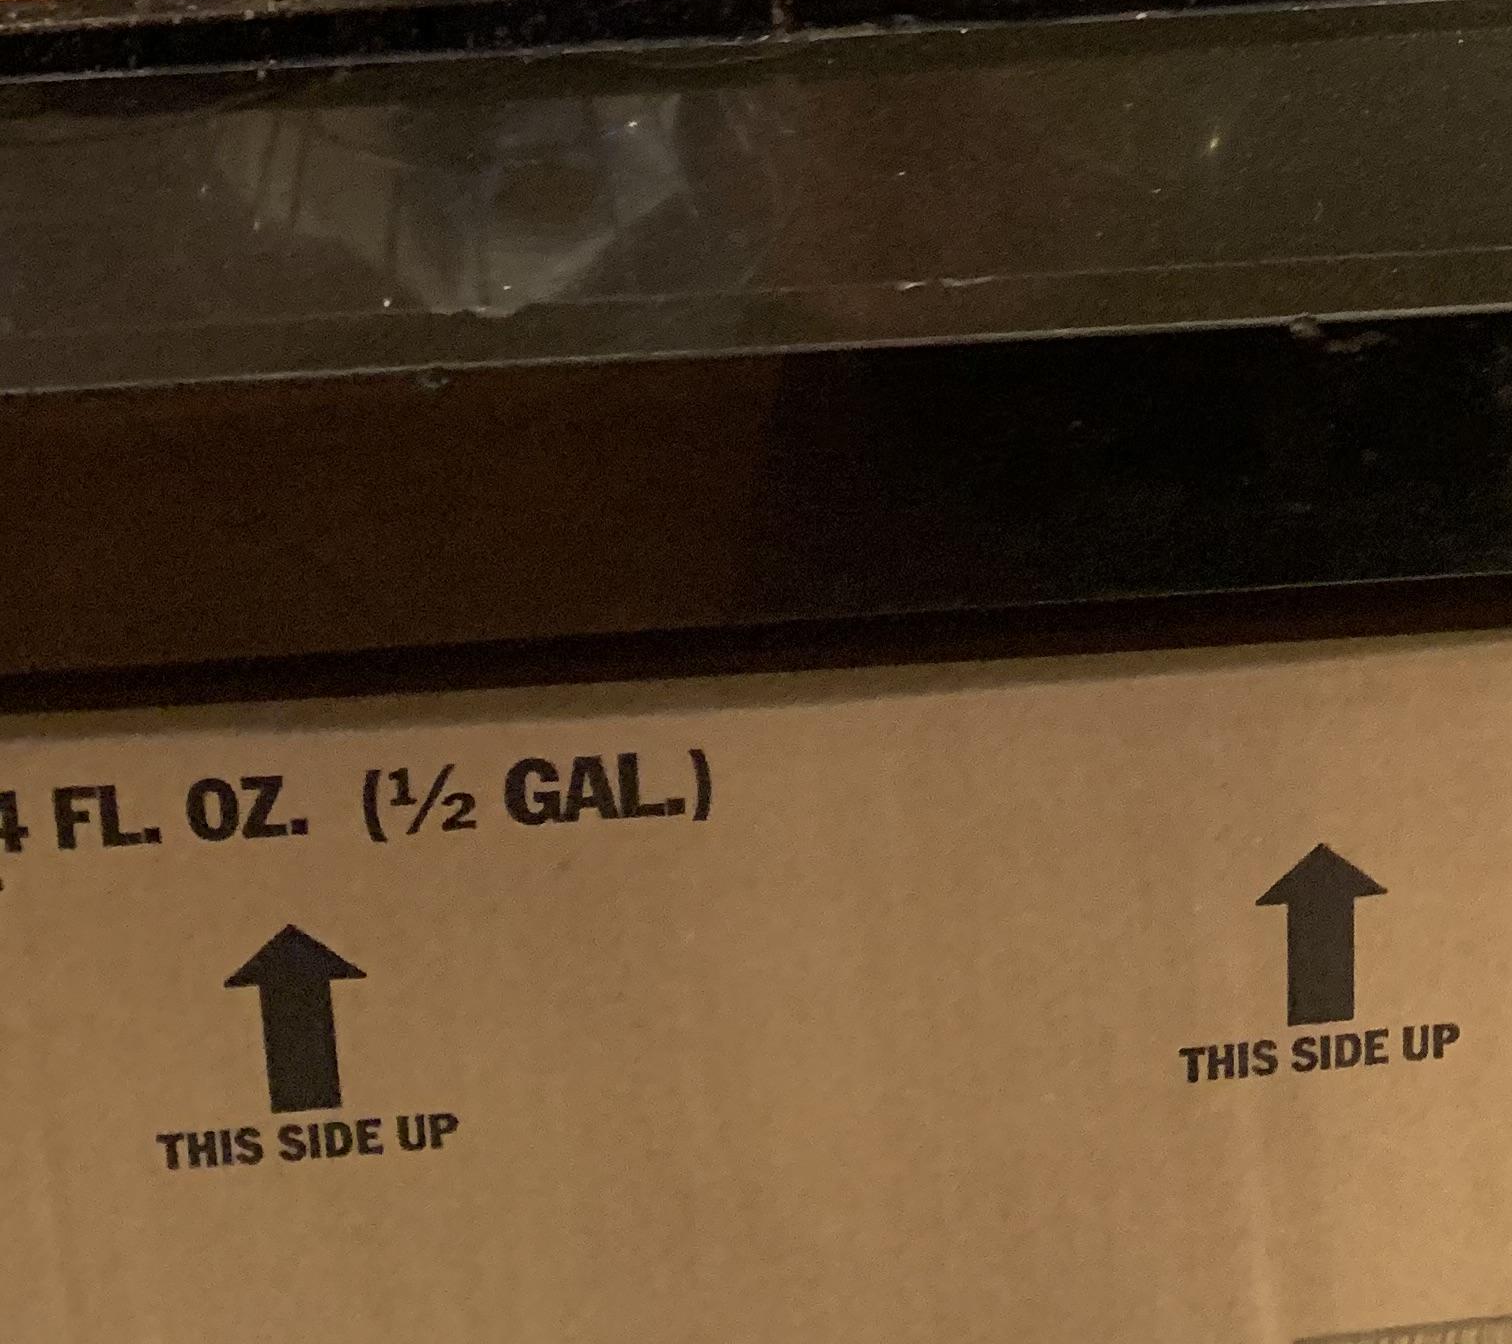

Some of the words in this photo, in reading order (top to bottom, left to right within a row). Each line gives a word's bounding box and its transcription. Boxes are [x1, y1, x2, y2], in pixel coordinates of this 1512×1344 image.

[52, 785, 162, 849] FL.
[186, 775, 309, 843] OZ.
[505, 749, 712, 825] GAL.)
[1179, 1039, 1279, 1082] THIS
[1291, 1028, 1389, 1073] SIDE
[1402, 1023, 1461, 1061] UP
[156, 1129, 264, 1169] THIS
[279, 1120, 385, 1161] SIDE
[398, 1113, 459, 1150] UP
